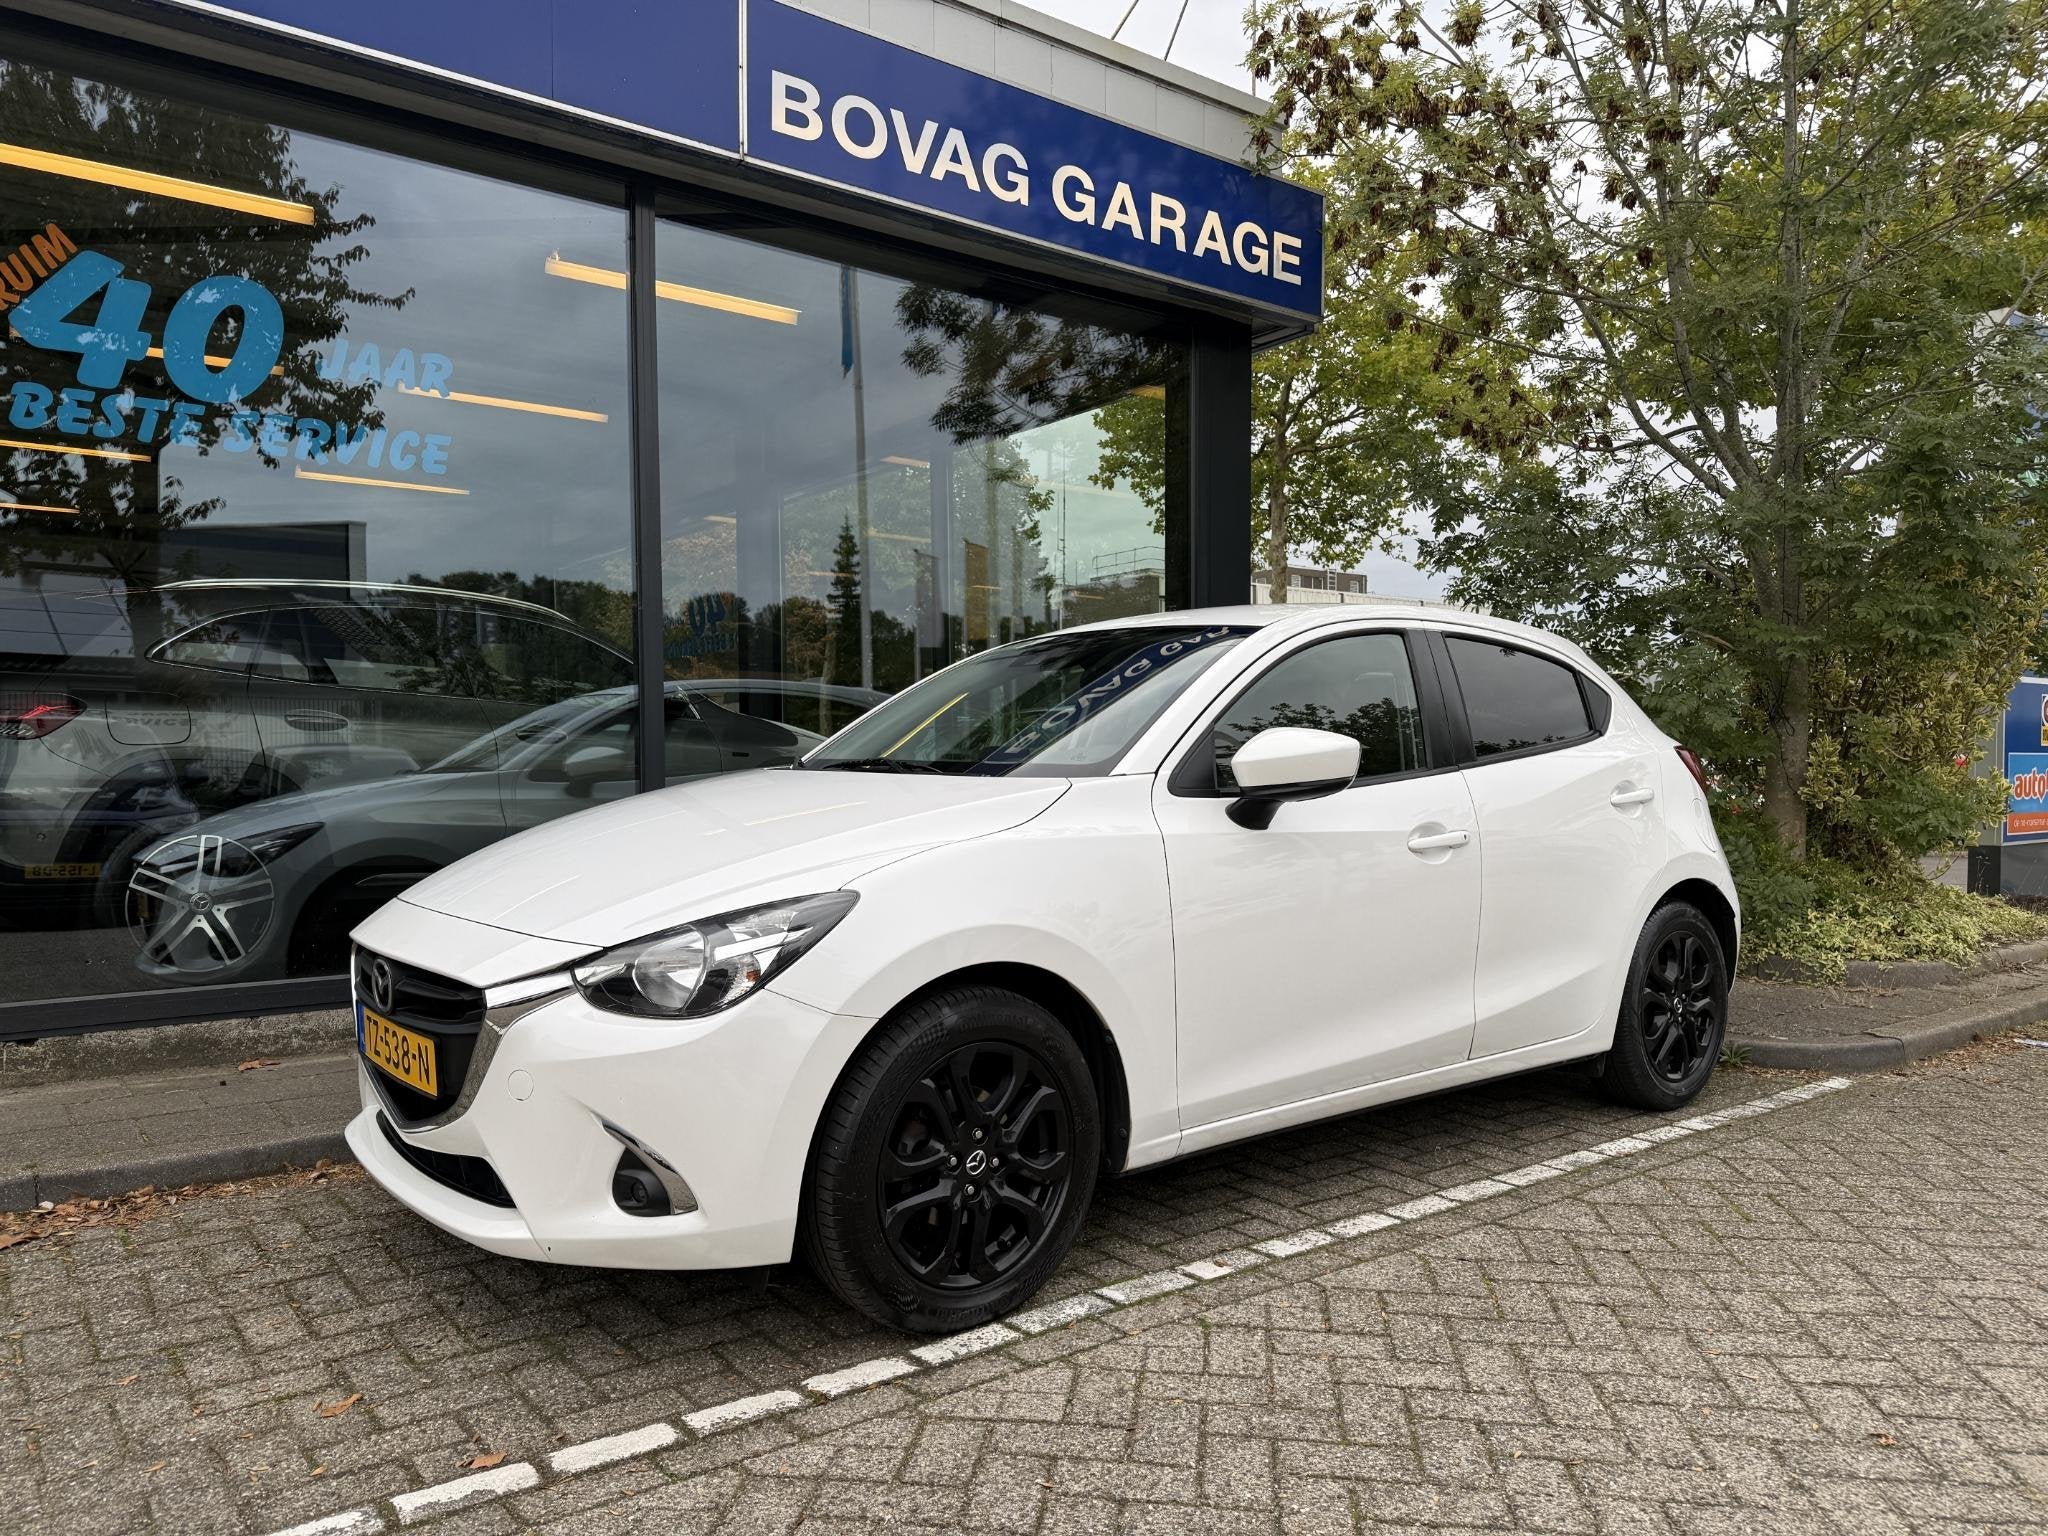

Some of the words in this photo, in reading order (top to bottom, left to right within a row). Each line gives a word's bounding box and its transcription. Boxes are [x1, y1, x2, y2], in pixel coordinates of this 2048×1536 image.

[770, 69, 1030, 207] BOVAG
[1051, 164, 1303, 286] GARAGE
[8, 249, 285, 404] 40
[317, 337, 454, 399] JAAR
[8, 381, 205, 447] BESTE
[222, 409, 453, 475] SERVICE
[366, 1014, 431, 1086] TZ-538-N
